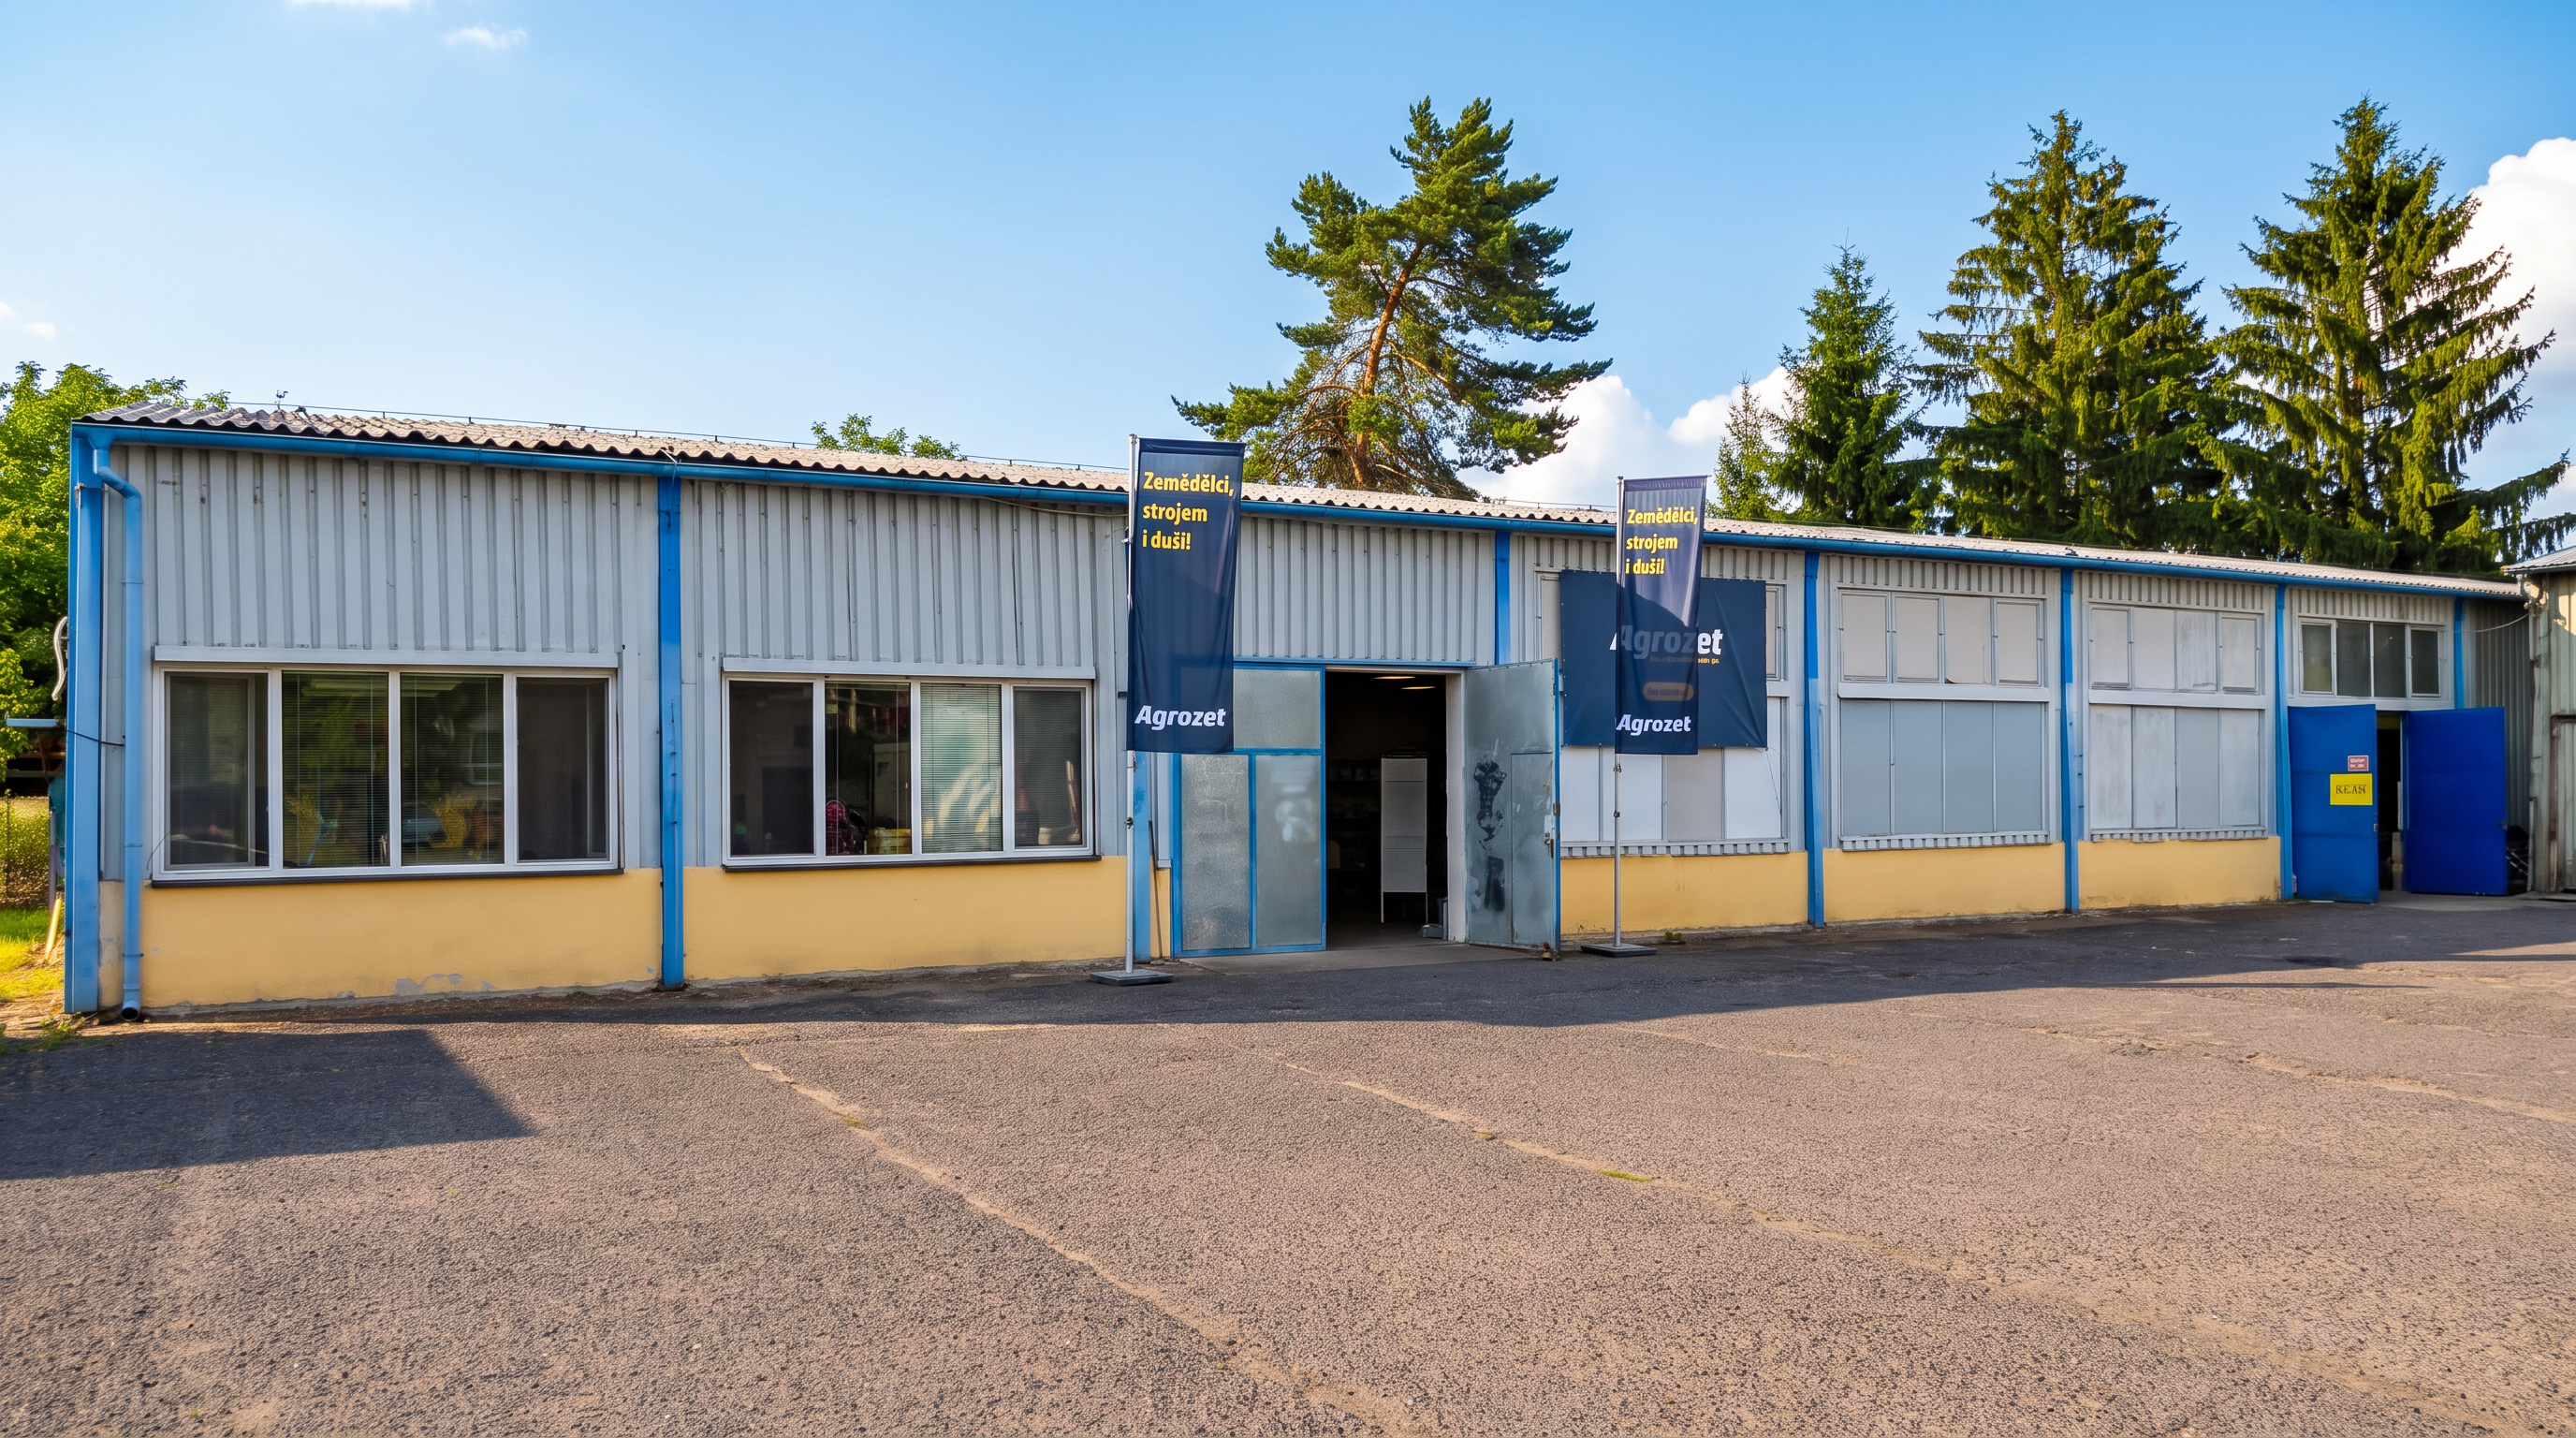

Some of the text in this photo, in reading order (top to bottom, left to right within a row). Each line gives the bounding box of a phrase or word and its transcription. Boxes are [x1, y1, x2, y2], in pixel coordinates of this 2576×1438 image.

[1142, 471, 1235, 497] Zemědělci,
[1142, 503, 1208, 526] strojem
[1626, 506, 1699, 526] Zemědělci,
[1142, 529, 1192, 550] i duši!
[1625, 533, 1678, 554] strojem
[1624, 558, 1665, 576] i duši!
[1609, 624, 1723, 659] Agrozet
[1134, 704, 1226, 731] Agrozet
[1616, 713, 1691, 736] Agrozet
